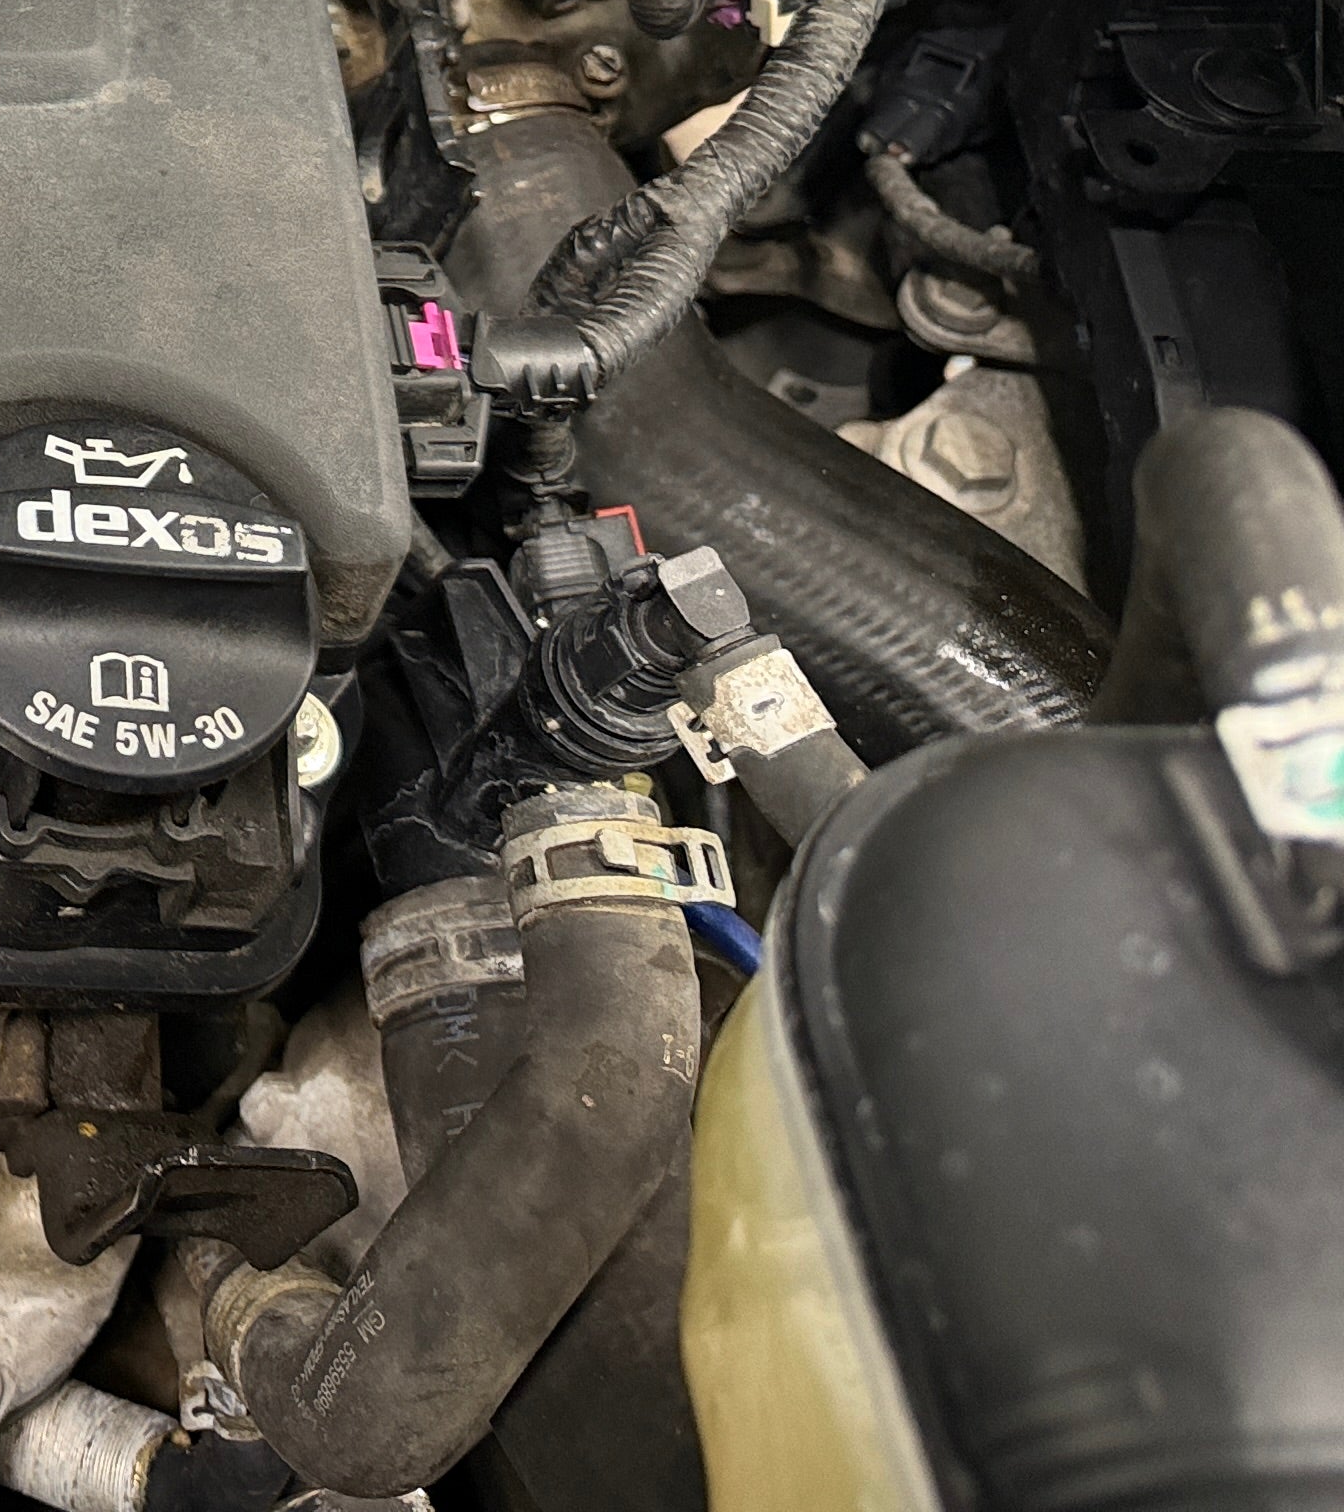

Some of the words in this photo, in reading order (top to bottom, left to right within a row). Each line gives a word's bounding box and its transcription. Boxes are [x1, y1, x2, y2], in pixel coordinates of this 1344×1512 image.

[24, 691, 100, 749] SAE
[115, 706, 245, 759] 5W-30
[356, 1309, 386, 1345] GM
